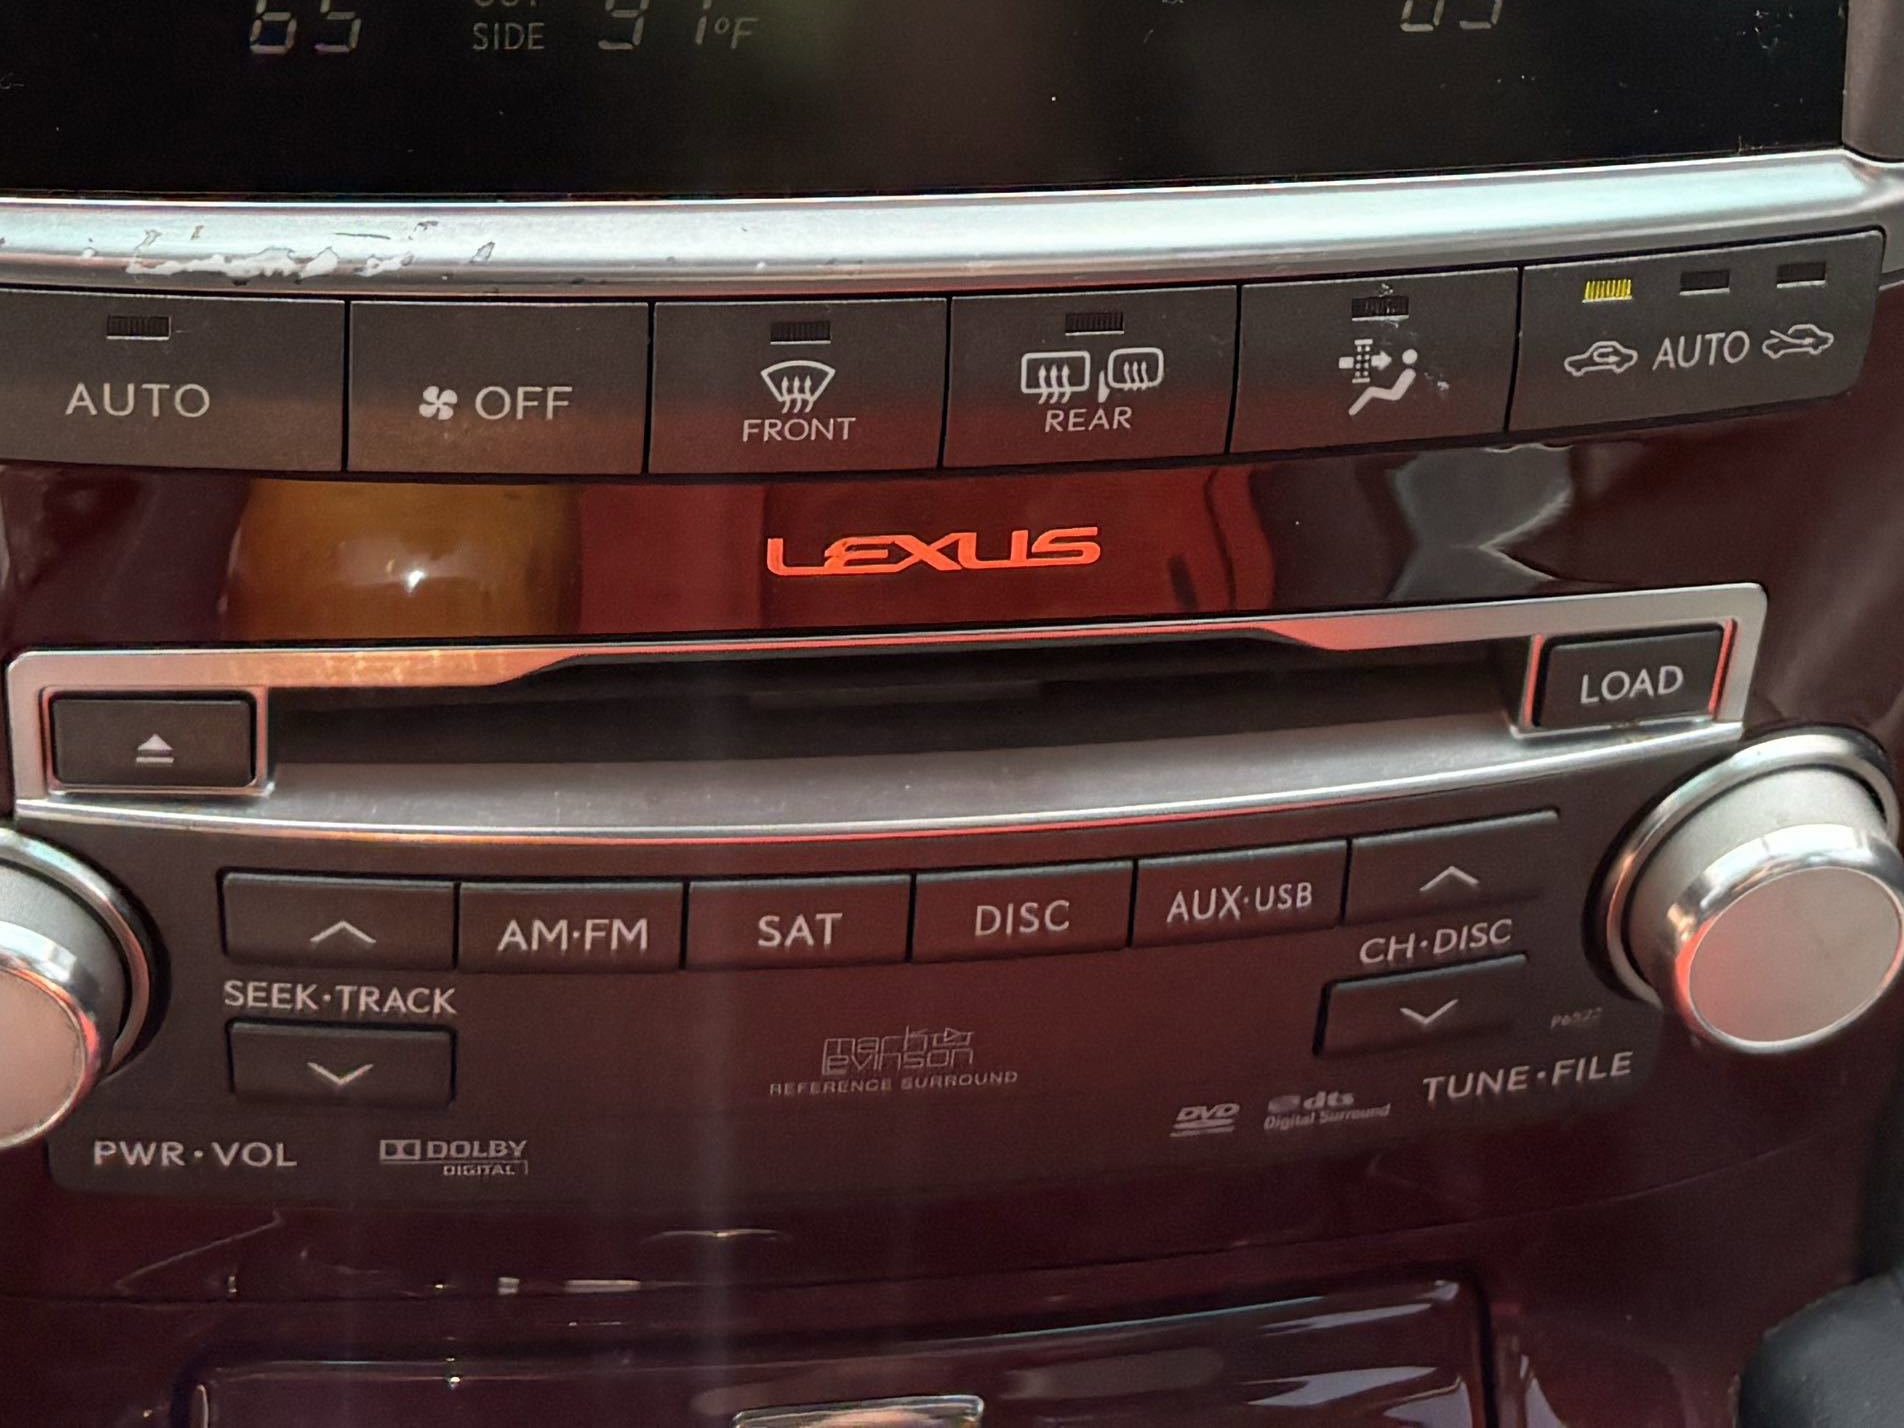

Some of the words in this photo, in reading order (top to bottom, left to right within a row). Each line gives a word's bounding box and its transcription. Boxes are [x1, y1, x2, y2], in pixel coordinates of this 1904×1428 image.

[472, 22, 546, 51] SIDE
[1651, 330, 1751, 371] AUTO
[64, 382, 211, 418] AUTO
[474, 386, 573, 421] OFF
[742, 416, 857, 442] FRONT
[1044, 405, 1133, 433] REAR
[766, 526, 1102, 576] LEXUS
[1580, 664, 1684, 706] LOAD
[757, 912, 844, 948] SAT
[973, 899, 1071, 937] DISC
[769, 1076, 893, 1097] REFERENCE
[900, 1070, 1019, 1091] SURROUND
[1175, 1102, 1241, 1122] DVD
[1303, 1091, 1355, 1111] dts
[426, 1140, 528, 1159] DOLBY
[442, 1164, 516, 1177] DIGITAL
